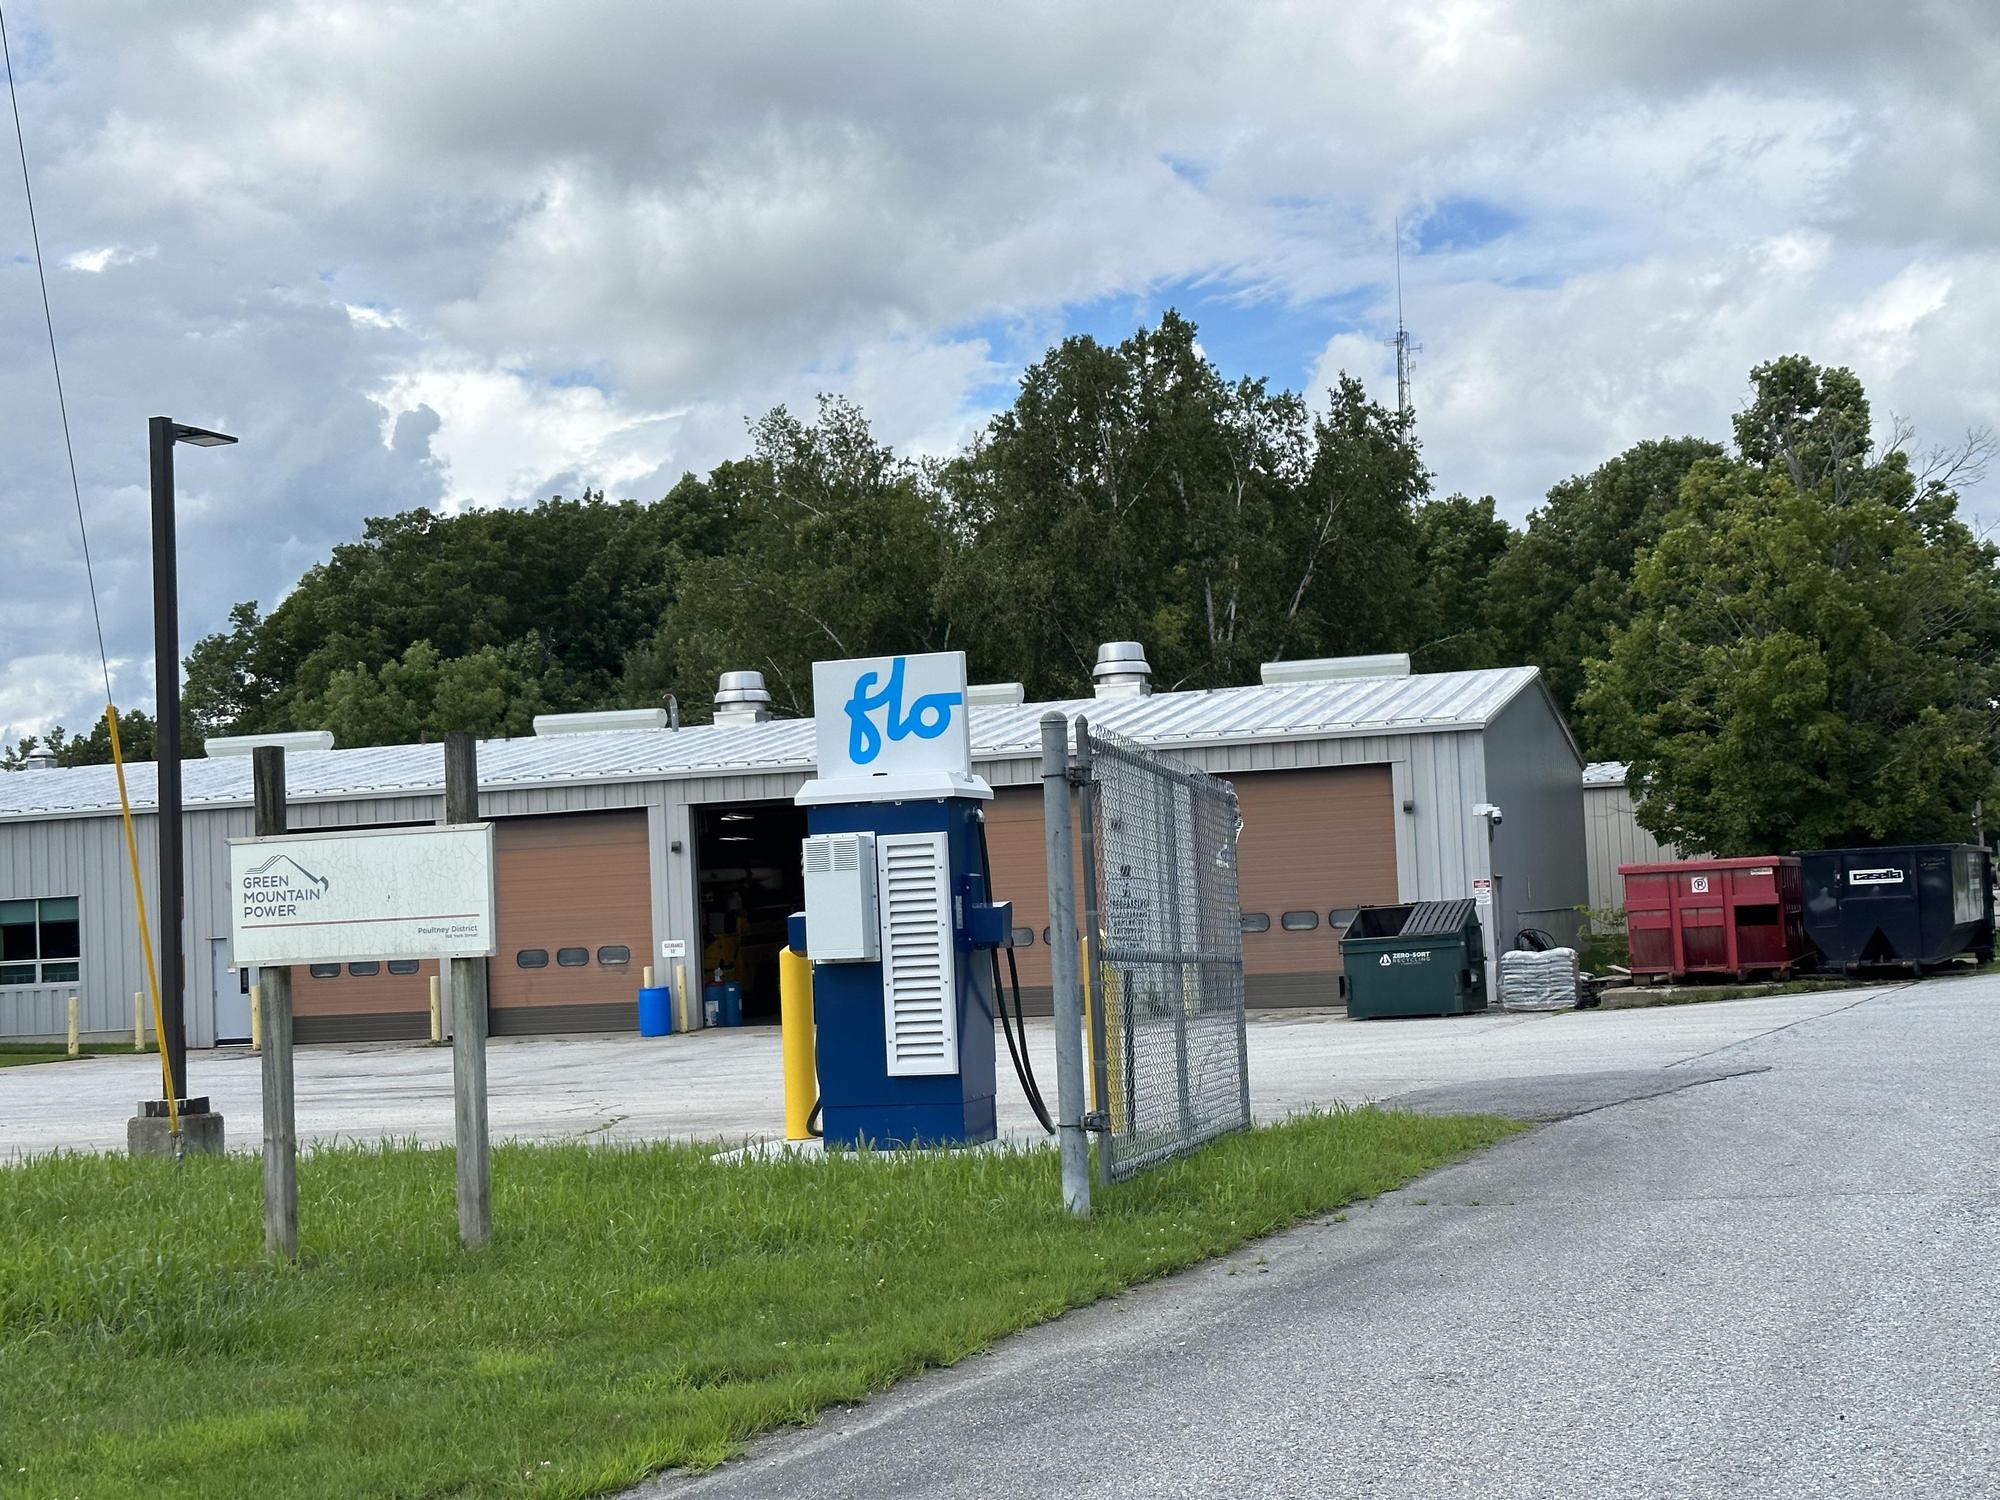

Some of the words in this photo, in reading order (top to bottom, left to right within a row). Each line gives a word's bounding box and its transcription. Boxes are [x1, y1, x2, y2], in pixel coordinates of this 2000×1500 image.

[844, 657, 963, 765] flo
[243, 875, 289, 889] GREEN
[243, 888, 320, 904] MOUNTAIN
[244, 904, 297, 919] POWER
[451, 925, 478, 933] District
[1392, 951, 1431, 959] ZERO-SORT
